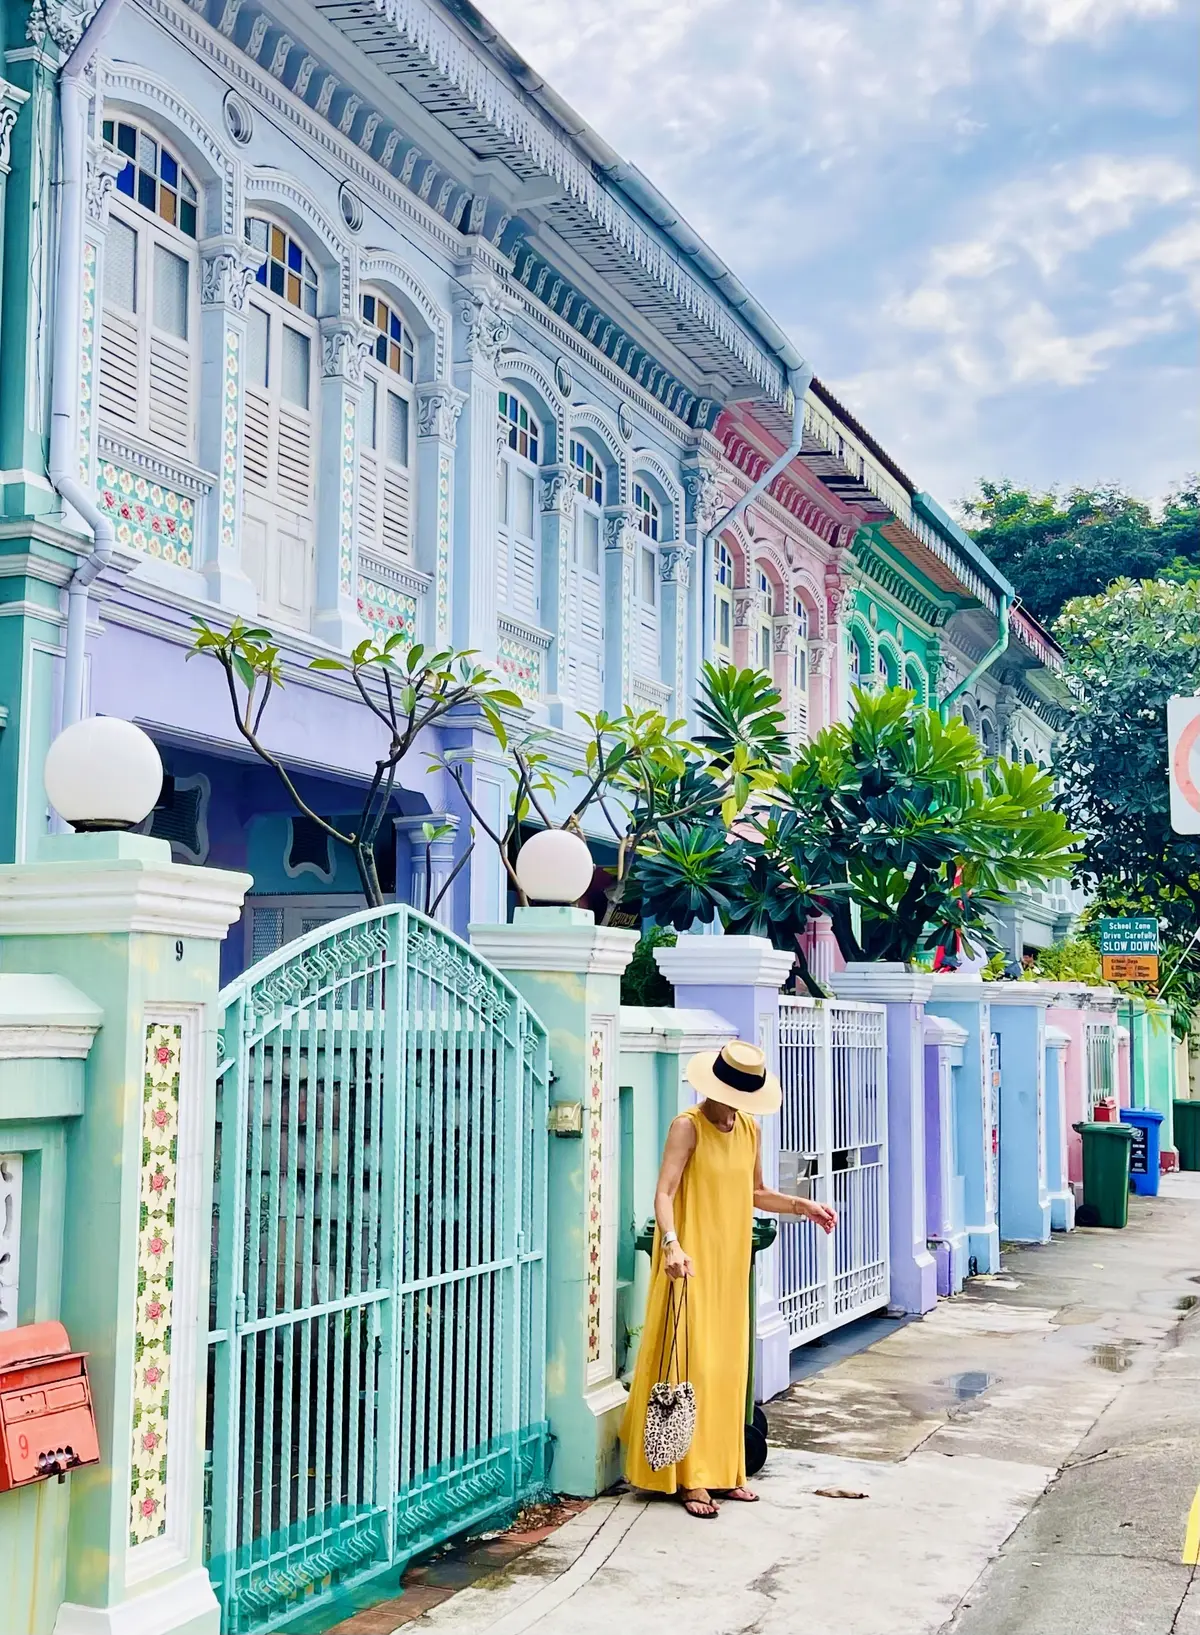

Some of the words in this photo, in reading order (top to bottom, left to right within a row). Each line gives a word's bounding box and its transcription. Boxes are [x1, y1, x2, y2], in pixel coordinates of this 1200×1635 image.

[1109, 922, 1131, 930] School
[1135, 922, 1151, 930] Zone
[1125, 932, 1156, 941] Carefully
[176, 940, 183, 961] 9
[1103, 942, 1128, 951] SLOW
[1131, 942, 1157, 951] DOWN
[18, 1434, 29, 1459] 9
